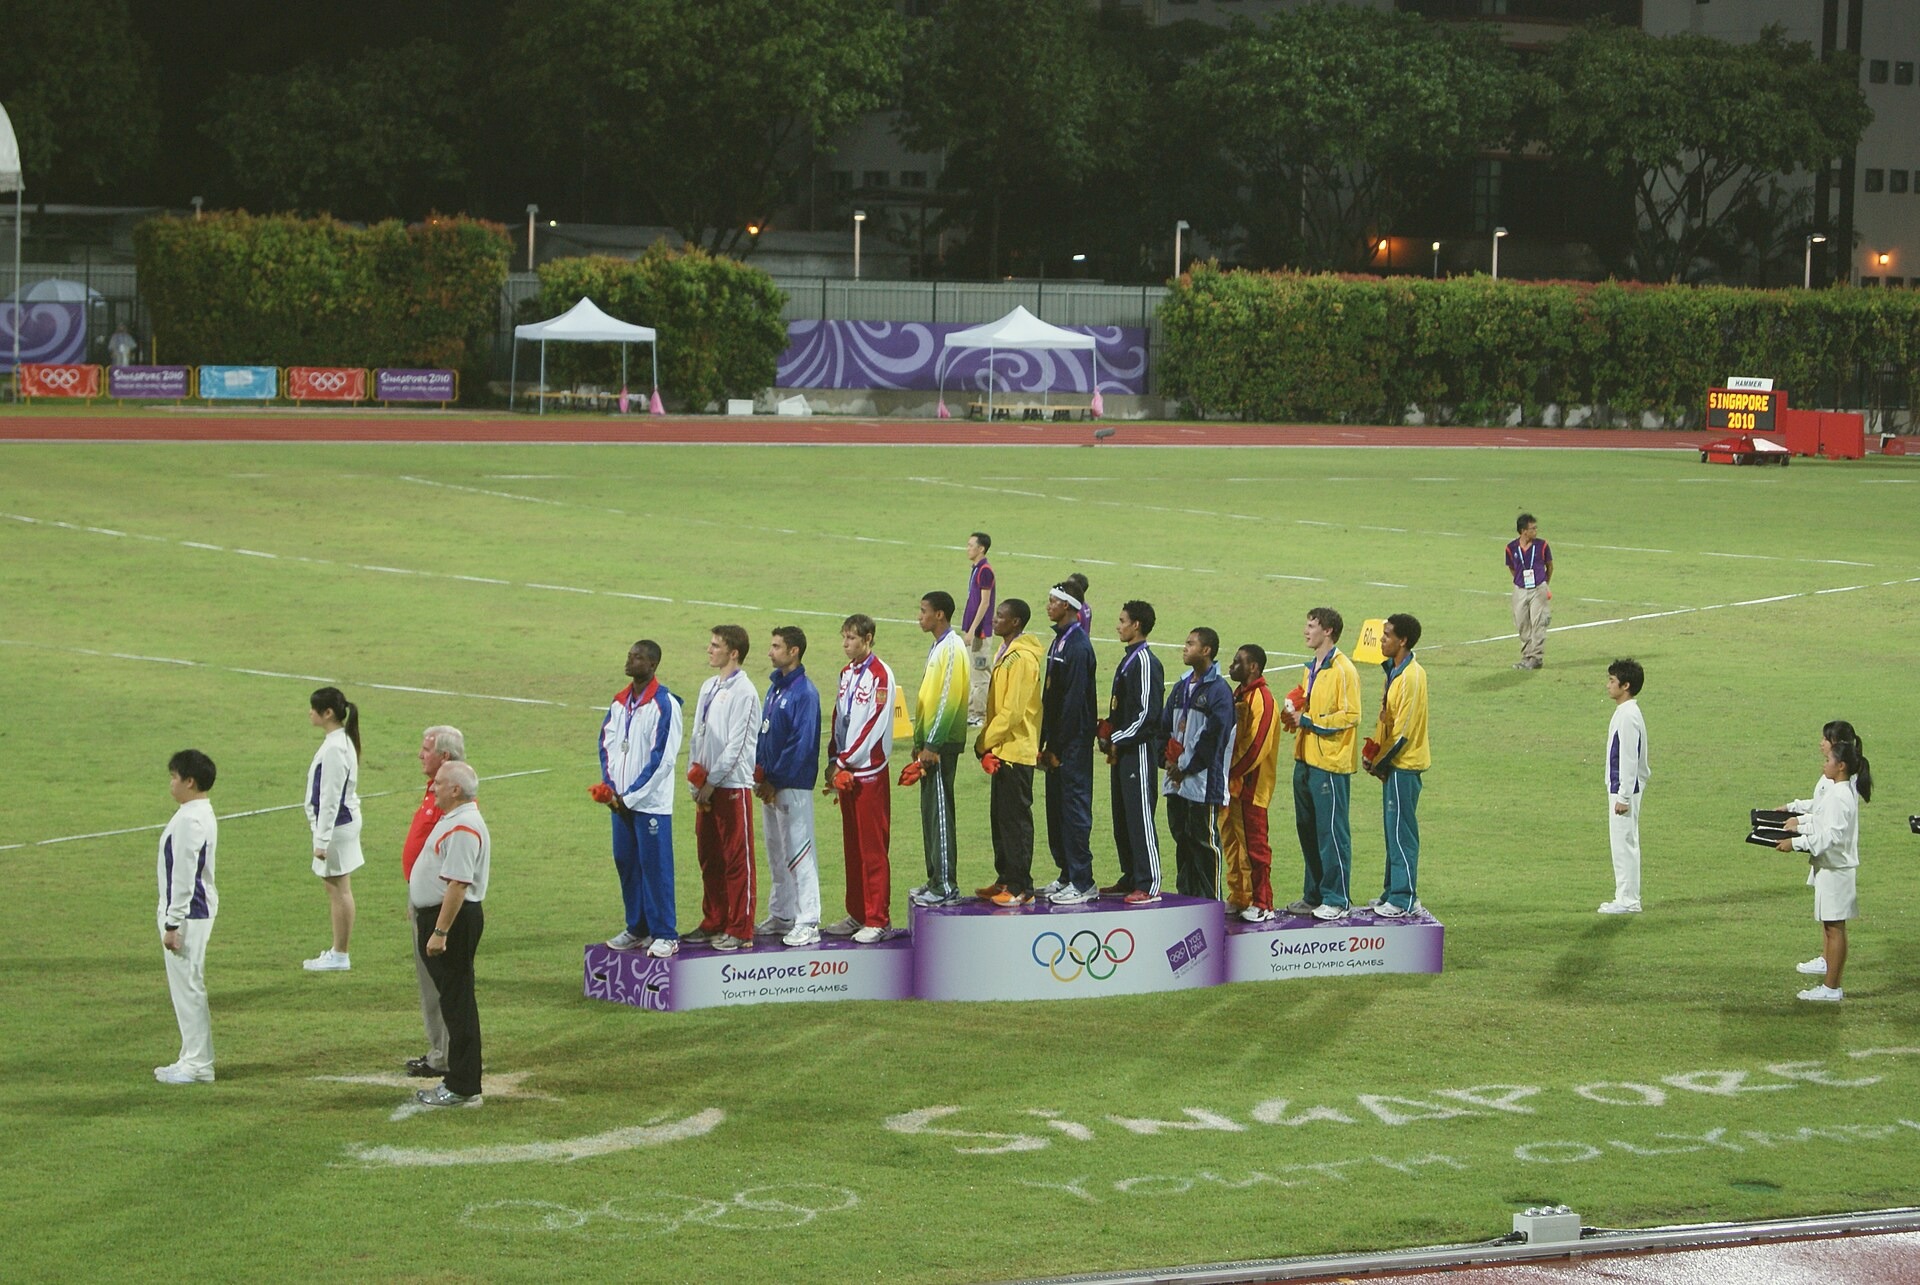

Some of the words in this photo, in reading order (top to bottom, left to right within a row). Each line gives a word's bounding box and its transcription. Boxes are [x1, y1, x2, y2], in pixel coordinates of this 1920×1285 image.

[428, 373, 450, 384] 2010
[1709, 392, 1769, 412] SINGAPORE
[1727, 412, 1755, 430] 2010
[1363, 627, 1377, 647] 60m
[1348, 936, 1385, 952] 2010
[809, 961, 849, 977] 2010
[1271, 963, 1301, 973] YOUTH
[1303, 960, 1345, 971] OLYMPIC
[1346, 959, 1384, 968] GAMES
[722, 989, 756, 1000] YOUTH
[759, 986, 805, 997] OLYMPIC
[807, 984, 848, 993] GAMES
